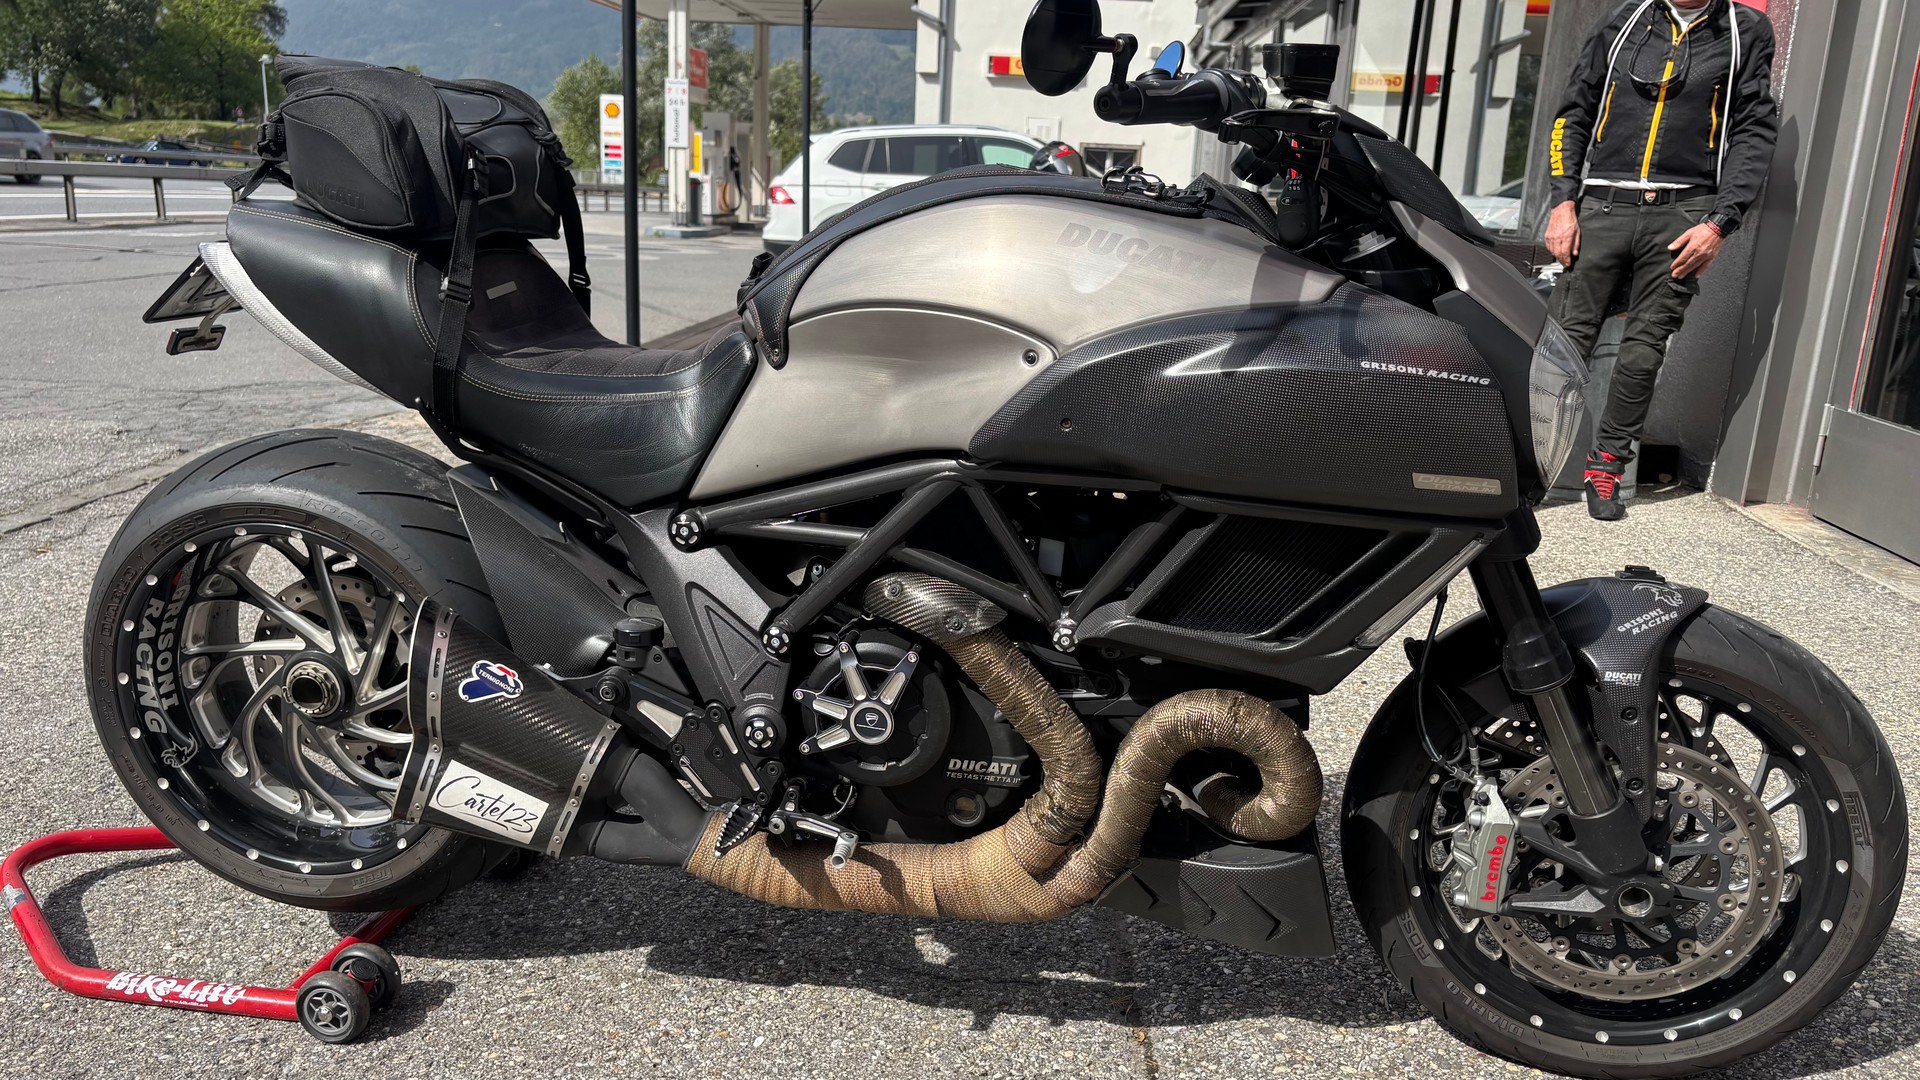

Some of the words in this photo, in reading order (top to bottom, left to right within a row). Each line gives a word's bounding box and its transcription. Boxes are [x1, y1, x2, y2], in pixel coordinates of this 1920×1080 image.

[1550, 117, 1567, 176] DUCATI
[1056, 222, 1217, 281] DUCATI
[1360, 360, 1424, 375] GRISONI
[1426, 369, 1491, 385] RACING
[1617, 608, 1664, 632] GRISONI
[1632, 611, 1678, 635] RACING
[136, 597, 168, 734] RACING
[157, 584, 192, 711] GRISONI
[478, 669, 515, 693] TERMIGNONI
[1604, 671, 1642, 680] DUCATI
[946, 771, 1011, 784] TESTASTRETTA
[947, 758, 1018, 776] DUCATI
[1480, 835, 1507, 902] brembo
[1400, 911, 1431, 961] ROSS
[1446, 981, 1525, 1039] DIABLO
